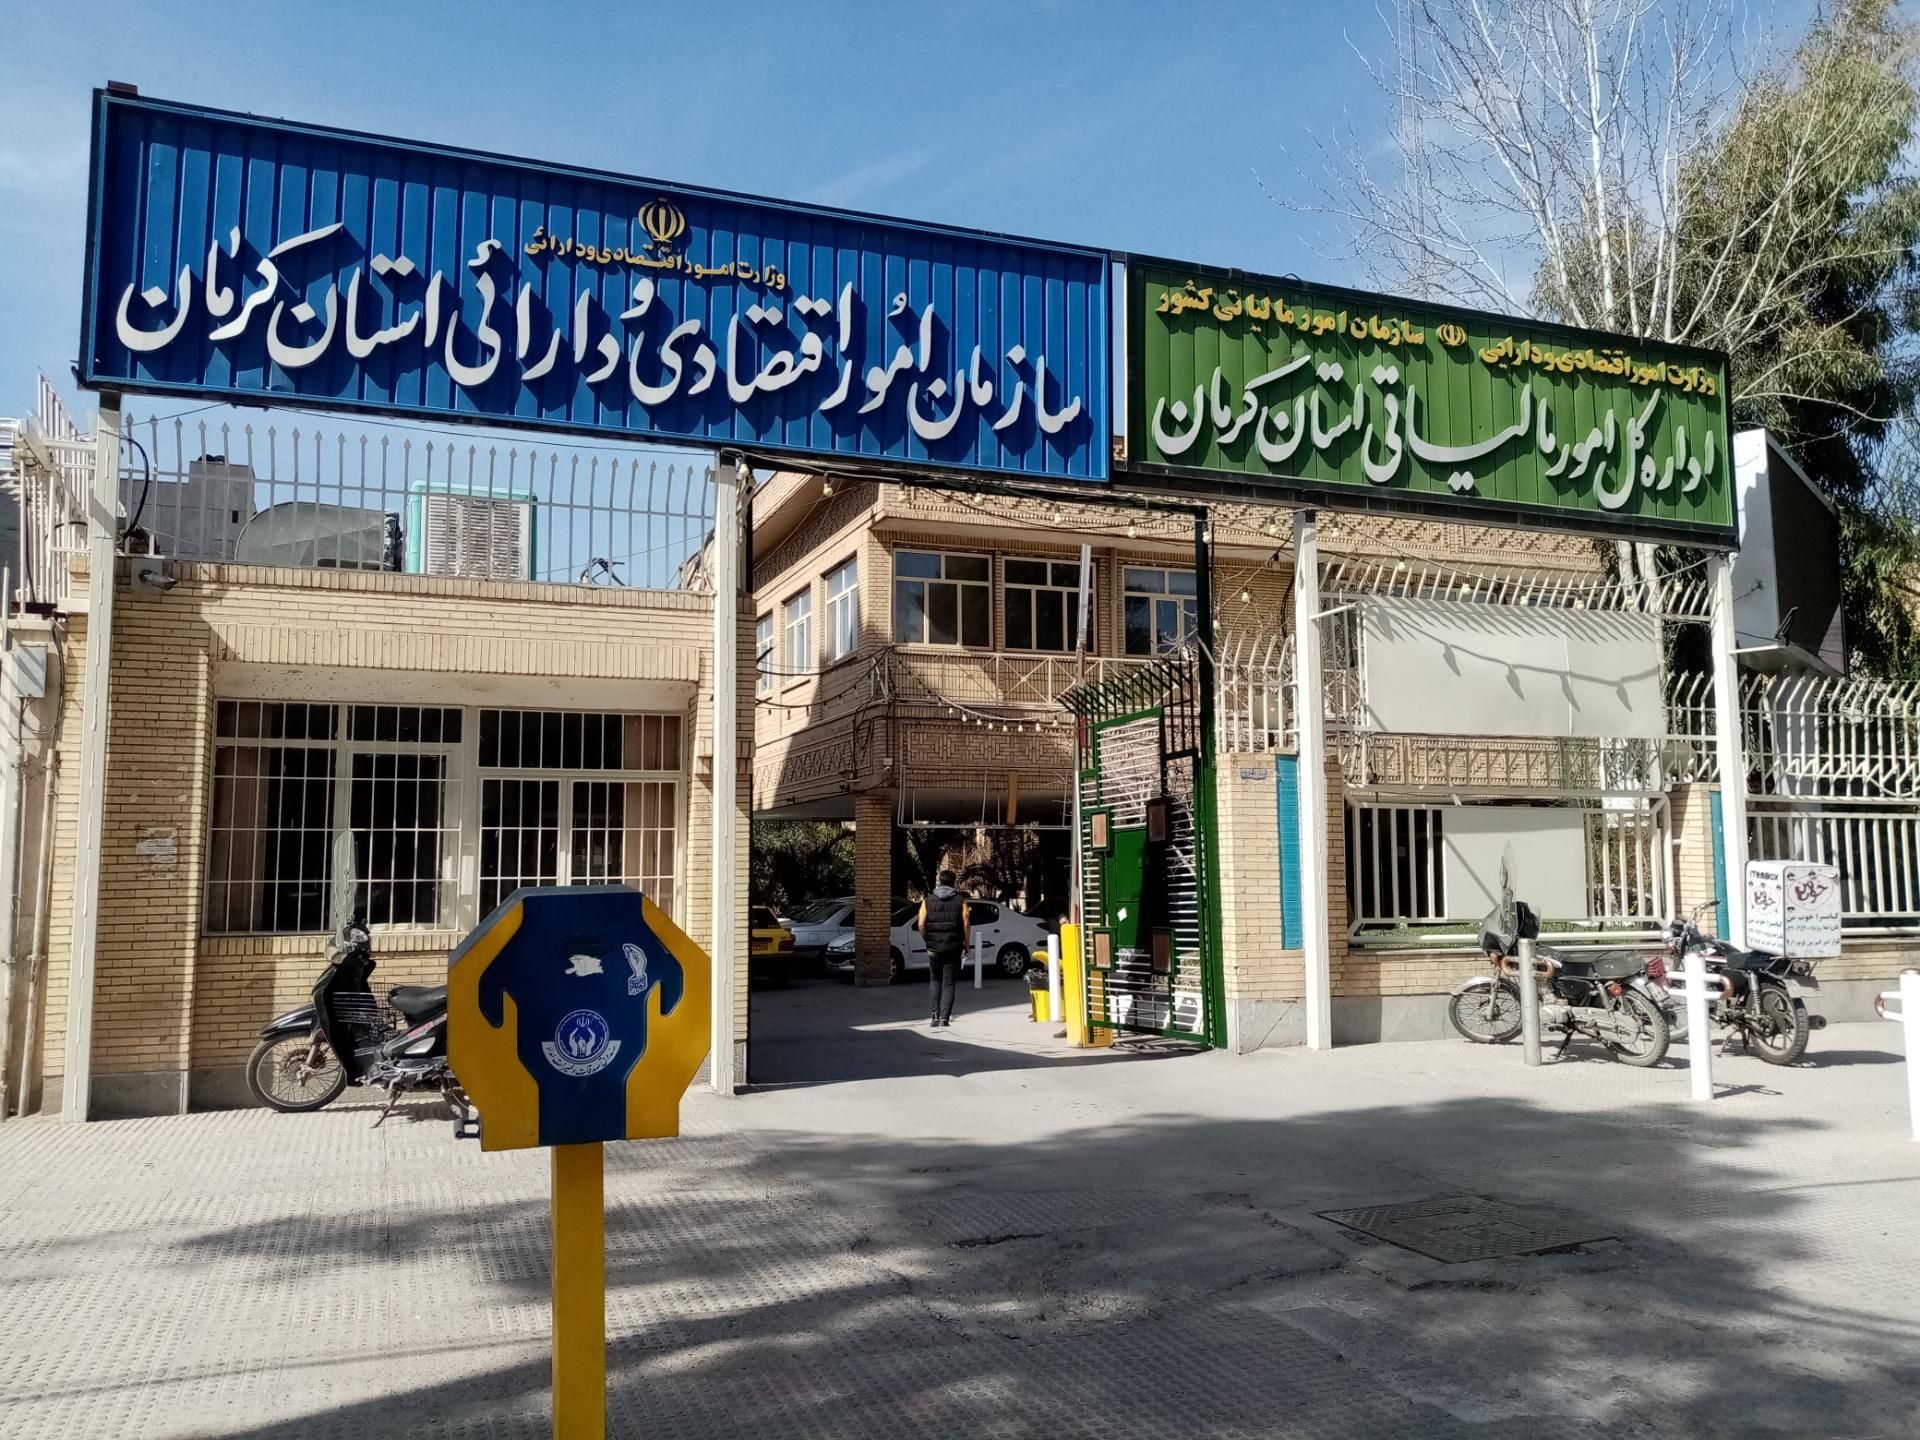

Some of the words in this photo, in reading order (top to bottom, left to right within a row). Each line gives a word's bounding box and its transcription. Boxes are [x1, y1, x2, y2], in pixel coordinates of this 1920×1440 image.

[596, 243, 683, 269] اقتصادی
[685, 261, 734, 280] امور
[737, 260, 786, 291] وزارت
[115, 221, 345, 353] کرمان
[266, 252, 442, 369] استان
[1154, 279, 1213, 315] کشور
[1213, 289, 1295, 333] مالیاتی
[629, 281, 853, 406] اقتصادی
[1299, 310, 1348, 336] امور
[1350, 316, 1425, 346] سازمان
[1556, 348, 1631, 377] اقتصادی
[1630, 361, 1666, 386] امور
[1667, 364, 1716, 397] وزارت
[907, 343, 1081, 440] سازمان
[1151, 354, 1313, 456] کرمان
[1255, 361, 1365, 463] استان
[1362, 364, 1558, 494] مالیاتی
[1545, 408, 1614, 480] امور
[1594, 387, 1661, 511] کل
[1640, 424, 1715, 493] اداره
